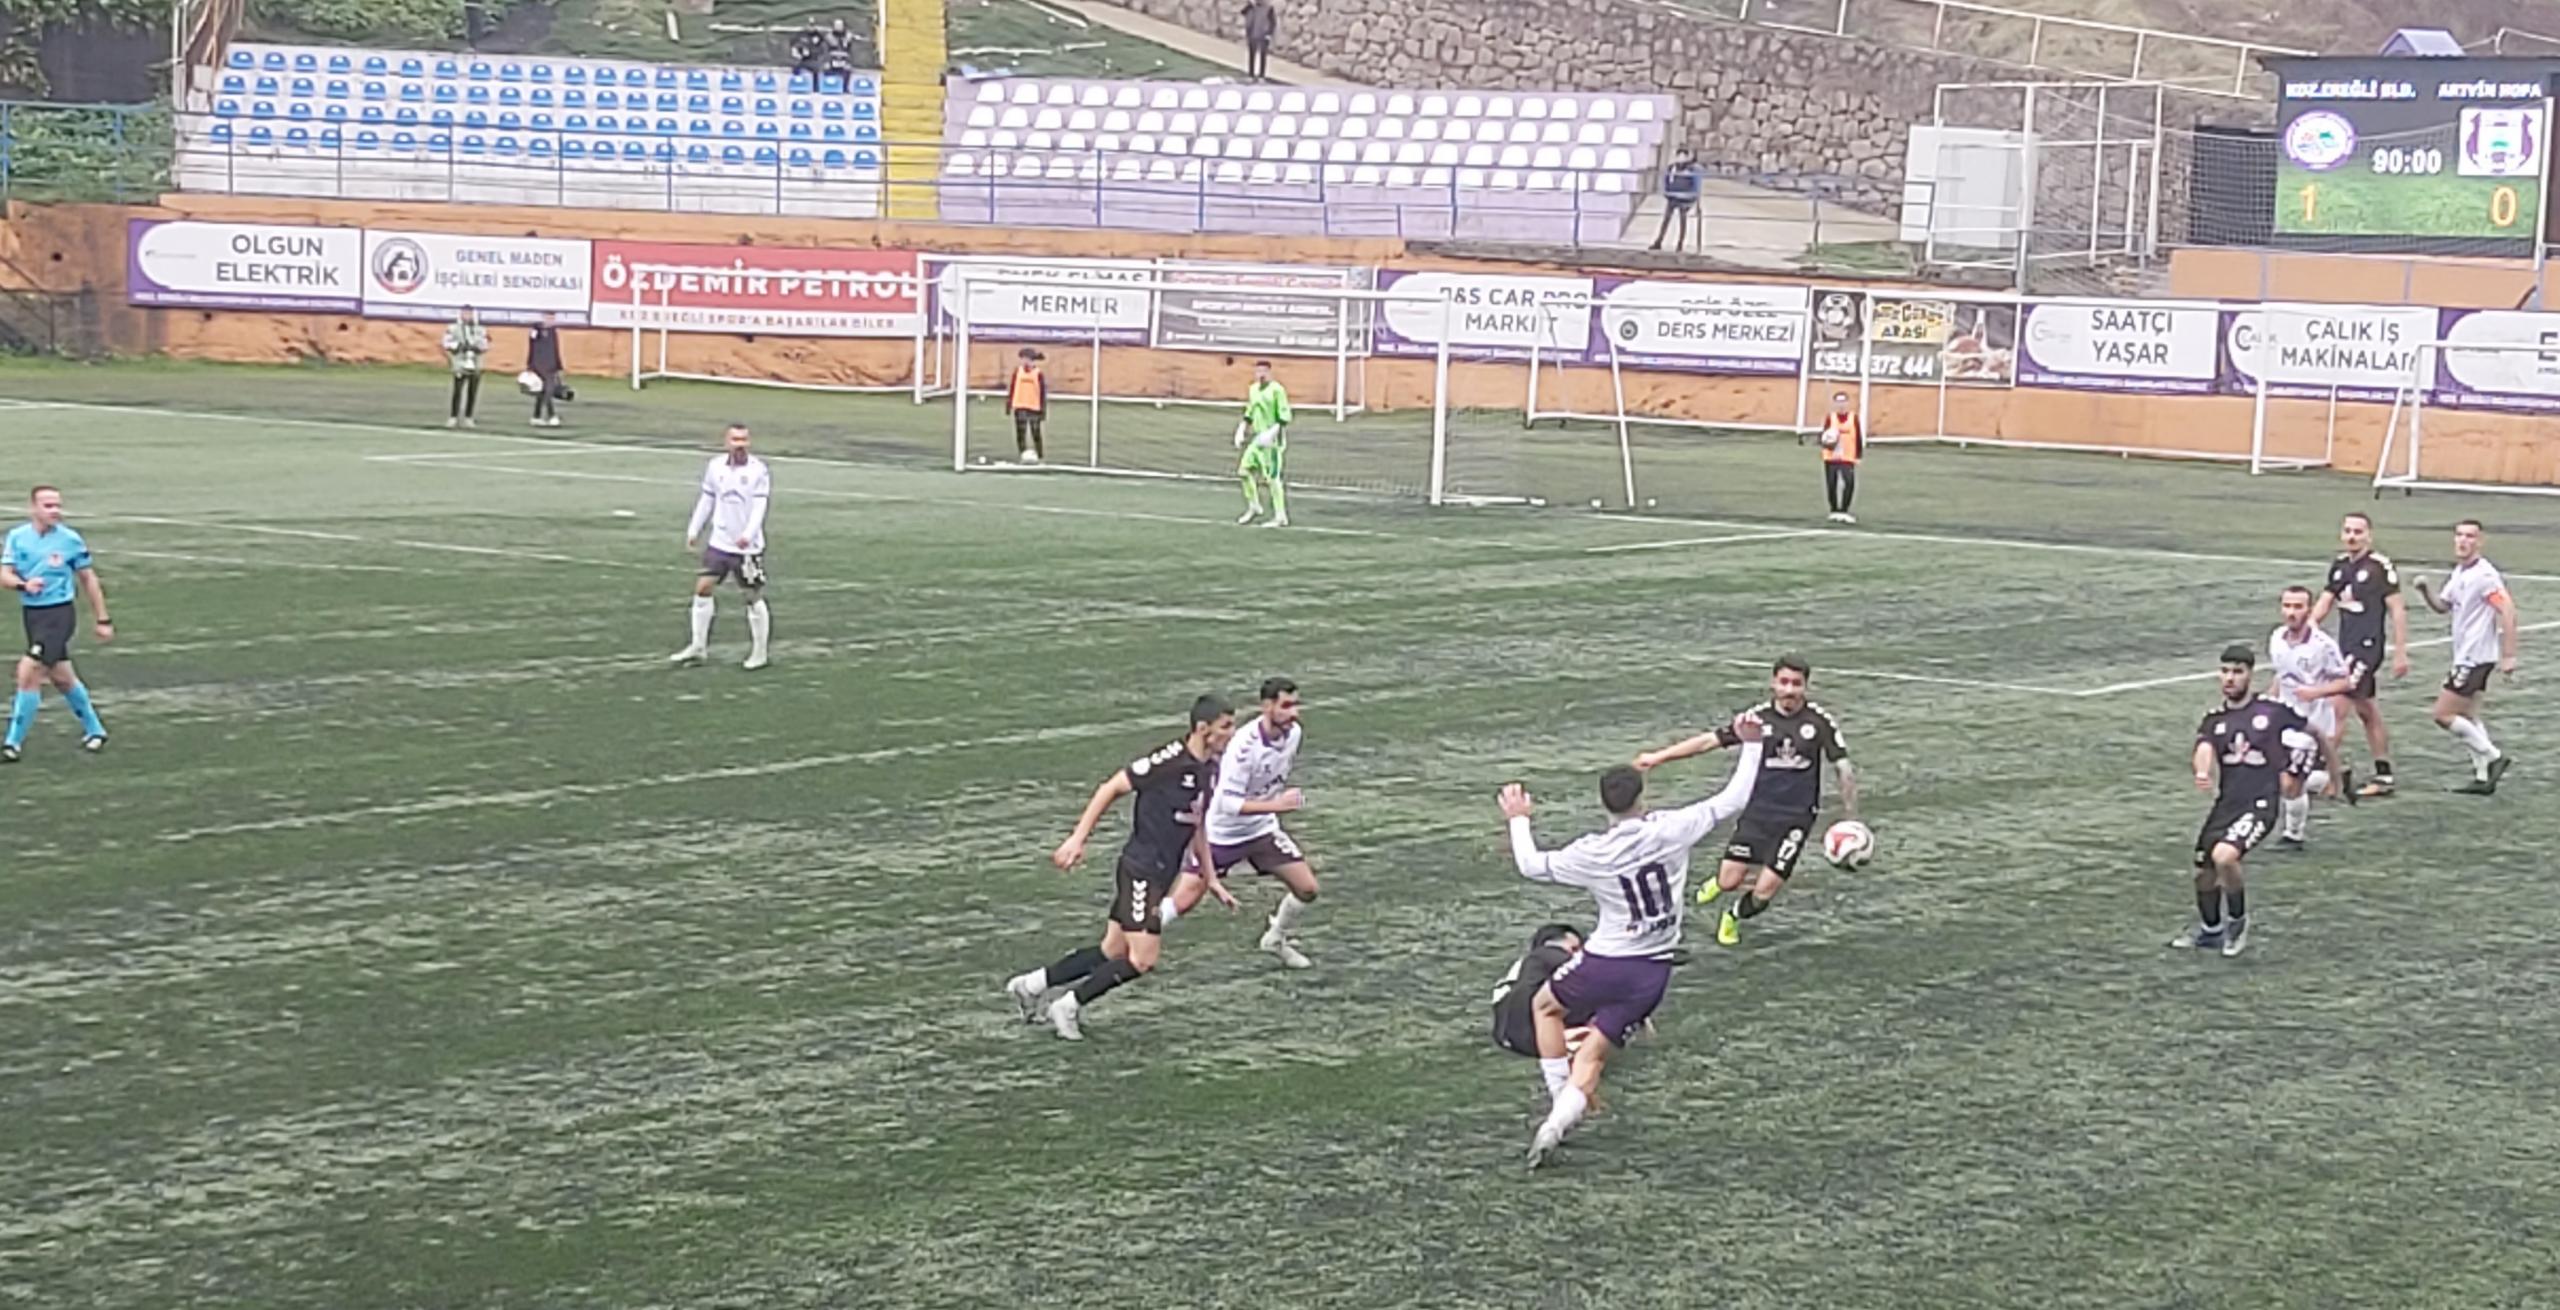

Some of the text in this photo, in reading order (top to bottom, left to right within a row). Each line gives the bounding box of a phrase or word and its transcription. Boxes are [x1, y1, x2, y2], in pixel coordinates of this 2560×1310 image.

[2371, 148, 2442, 175] 90:00
[2299, 184, 2317, 223] 1
[2490, 185, 2518, 228] 0
[231, 233, 324, 257] OLGUN
[456, 249, 564, 266] GENEL MADEN
[216, 260, 339, 286] ELEKTRİK
[780, 268, 917, 299] PETROL
[1489, 288, 1536, 307] CAR
[1657, 319, 1796, 342] DERS MERKEZİ
[2305, 316, 2400, 345] ÇALIK İŞ
[2092, 340, 2169, 367] YAŞAR
[2281, 343, 2417, 372] MAKİNALA
[1617, 862, 1675, 922] 10
